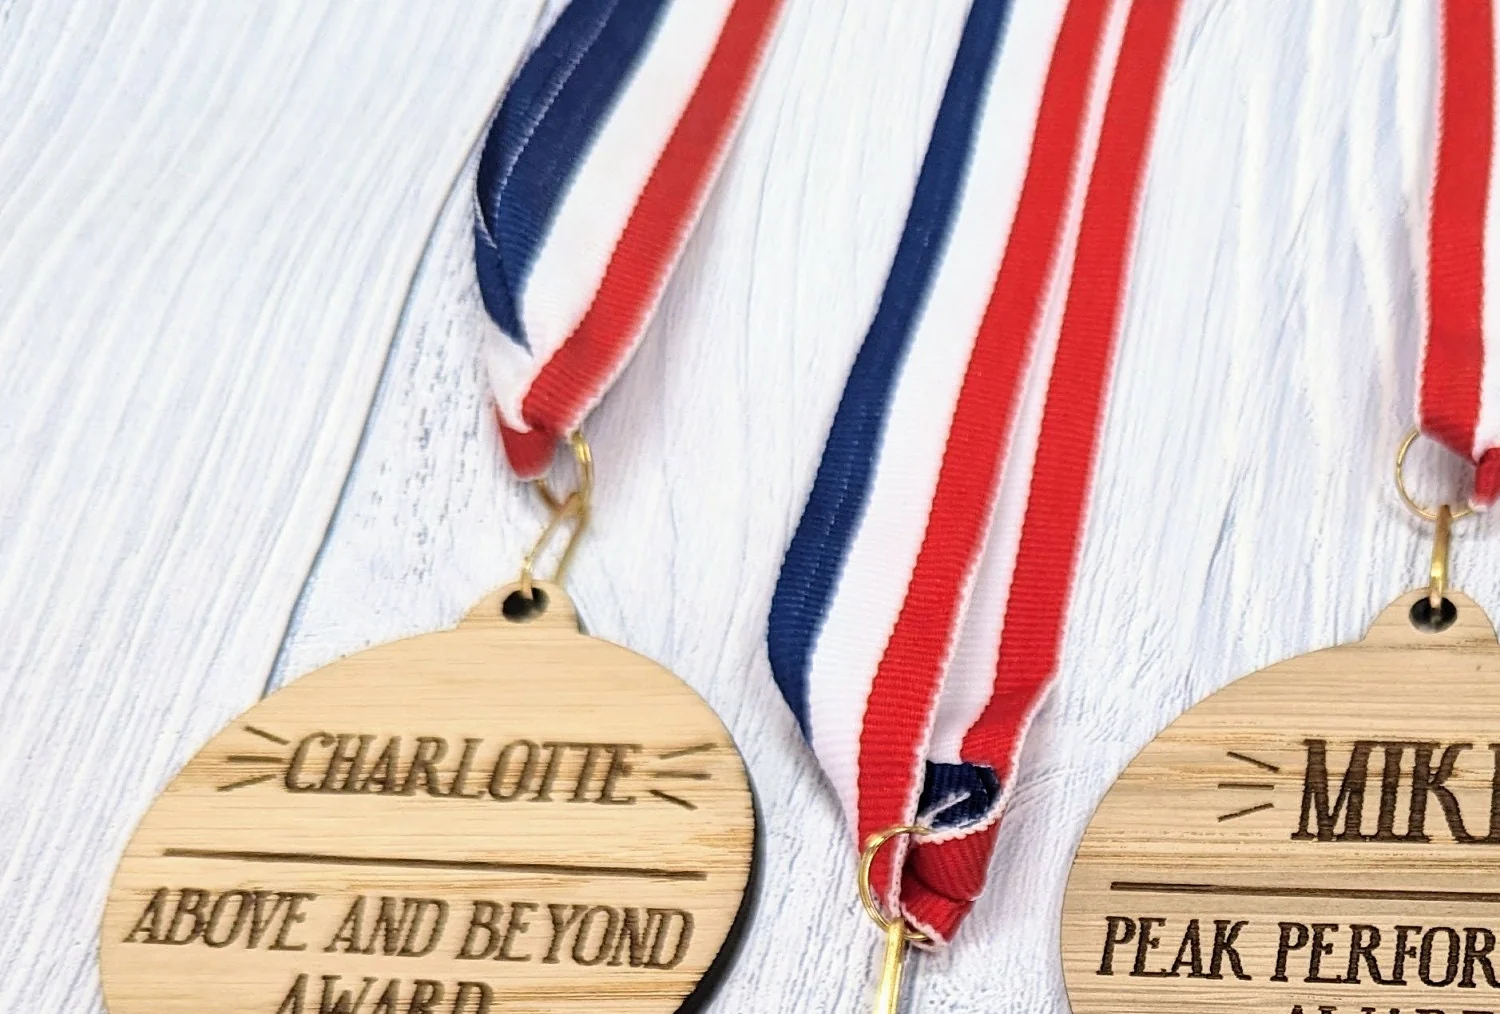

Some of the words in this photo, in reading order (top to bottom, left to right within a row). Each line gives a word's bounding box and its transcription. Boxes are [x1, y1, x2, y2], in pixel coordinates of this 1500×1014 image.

[284, 731, 638, 804] CHARLOTTE
[124, 888, 316, 951] ABOVE
[325, 896, 448, 958] AND
[455, 902, 694, 970] BEYOND
[1098, 916, 1251, 980] PEAK
